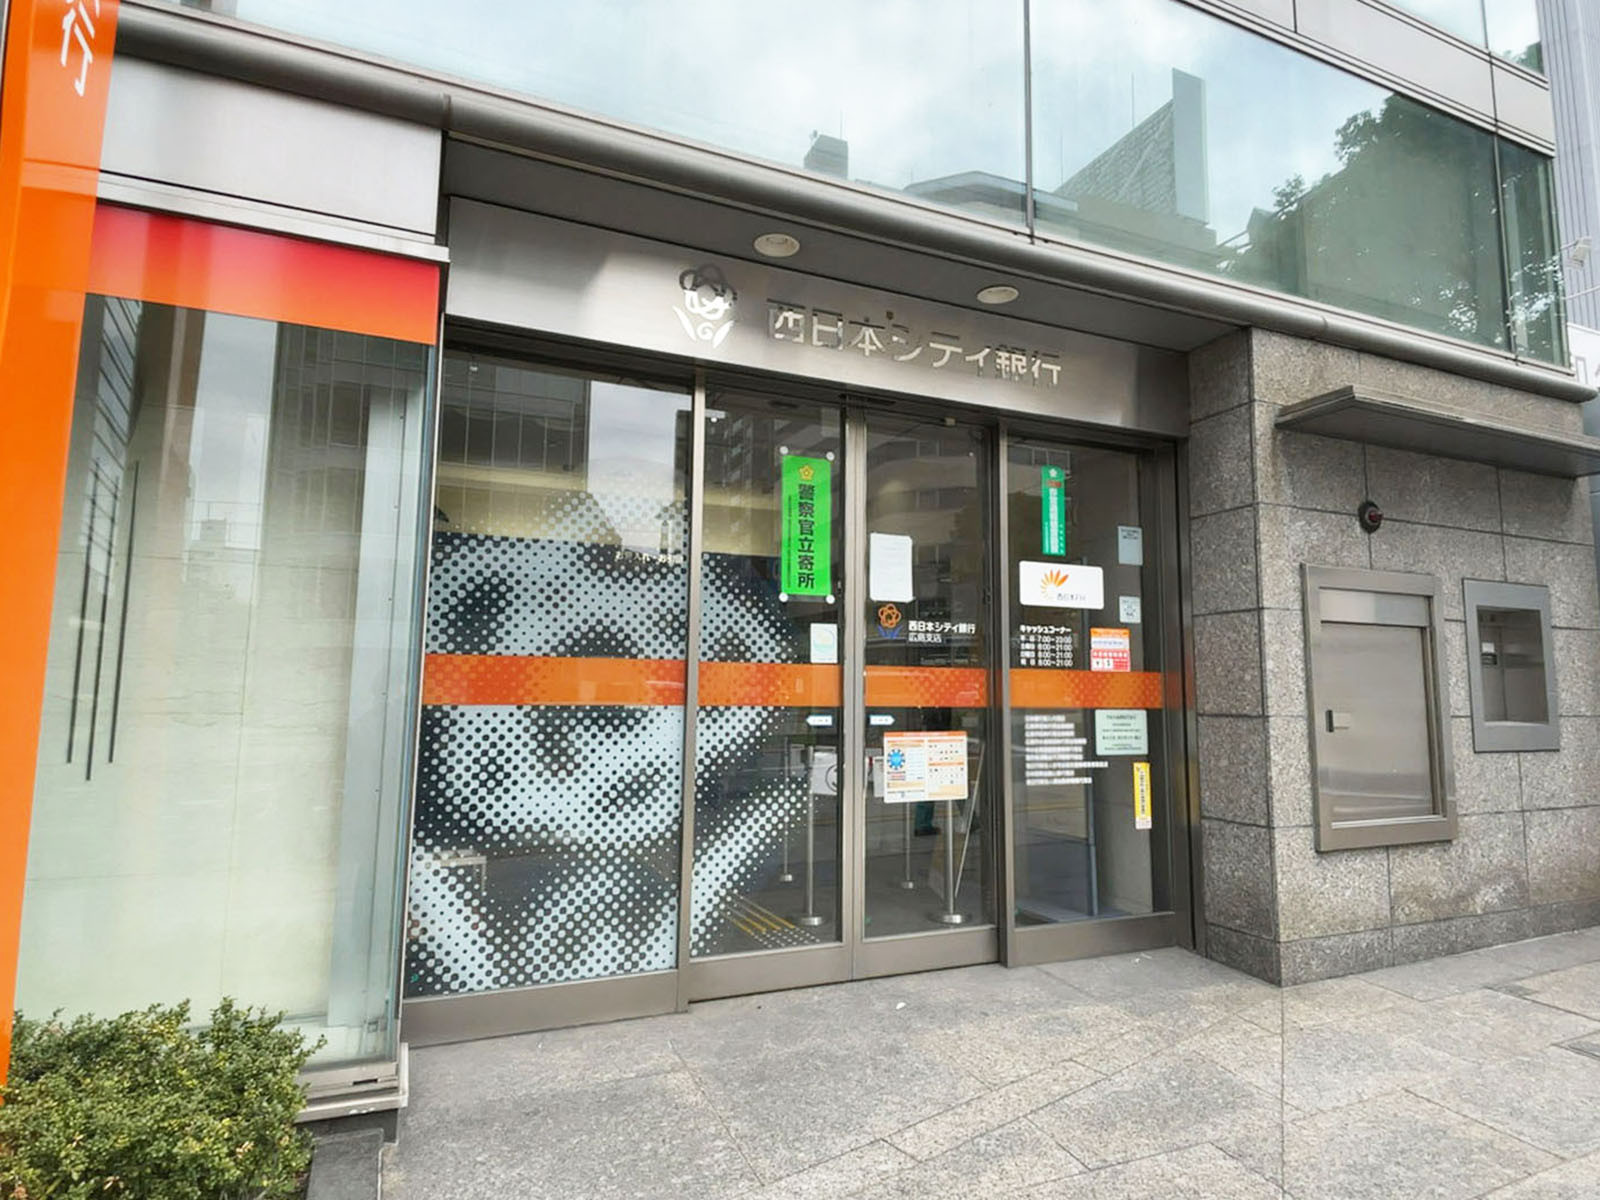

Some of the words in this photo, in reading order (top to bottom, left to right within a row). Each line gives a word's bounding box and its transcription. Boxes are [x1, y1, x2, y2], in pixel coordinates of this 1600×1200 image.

[766, 298, 1062, 386] 西日本シティ銀行
[797, 483, 815, 590] 警察官立寄所
[908, 620, 976, 635] 西日本シティ銀行
[1020, 624, 1072, 634] キャッシュコーナー
